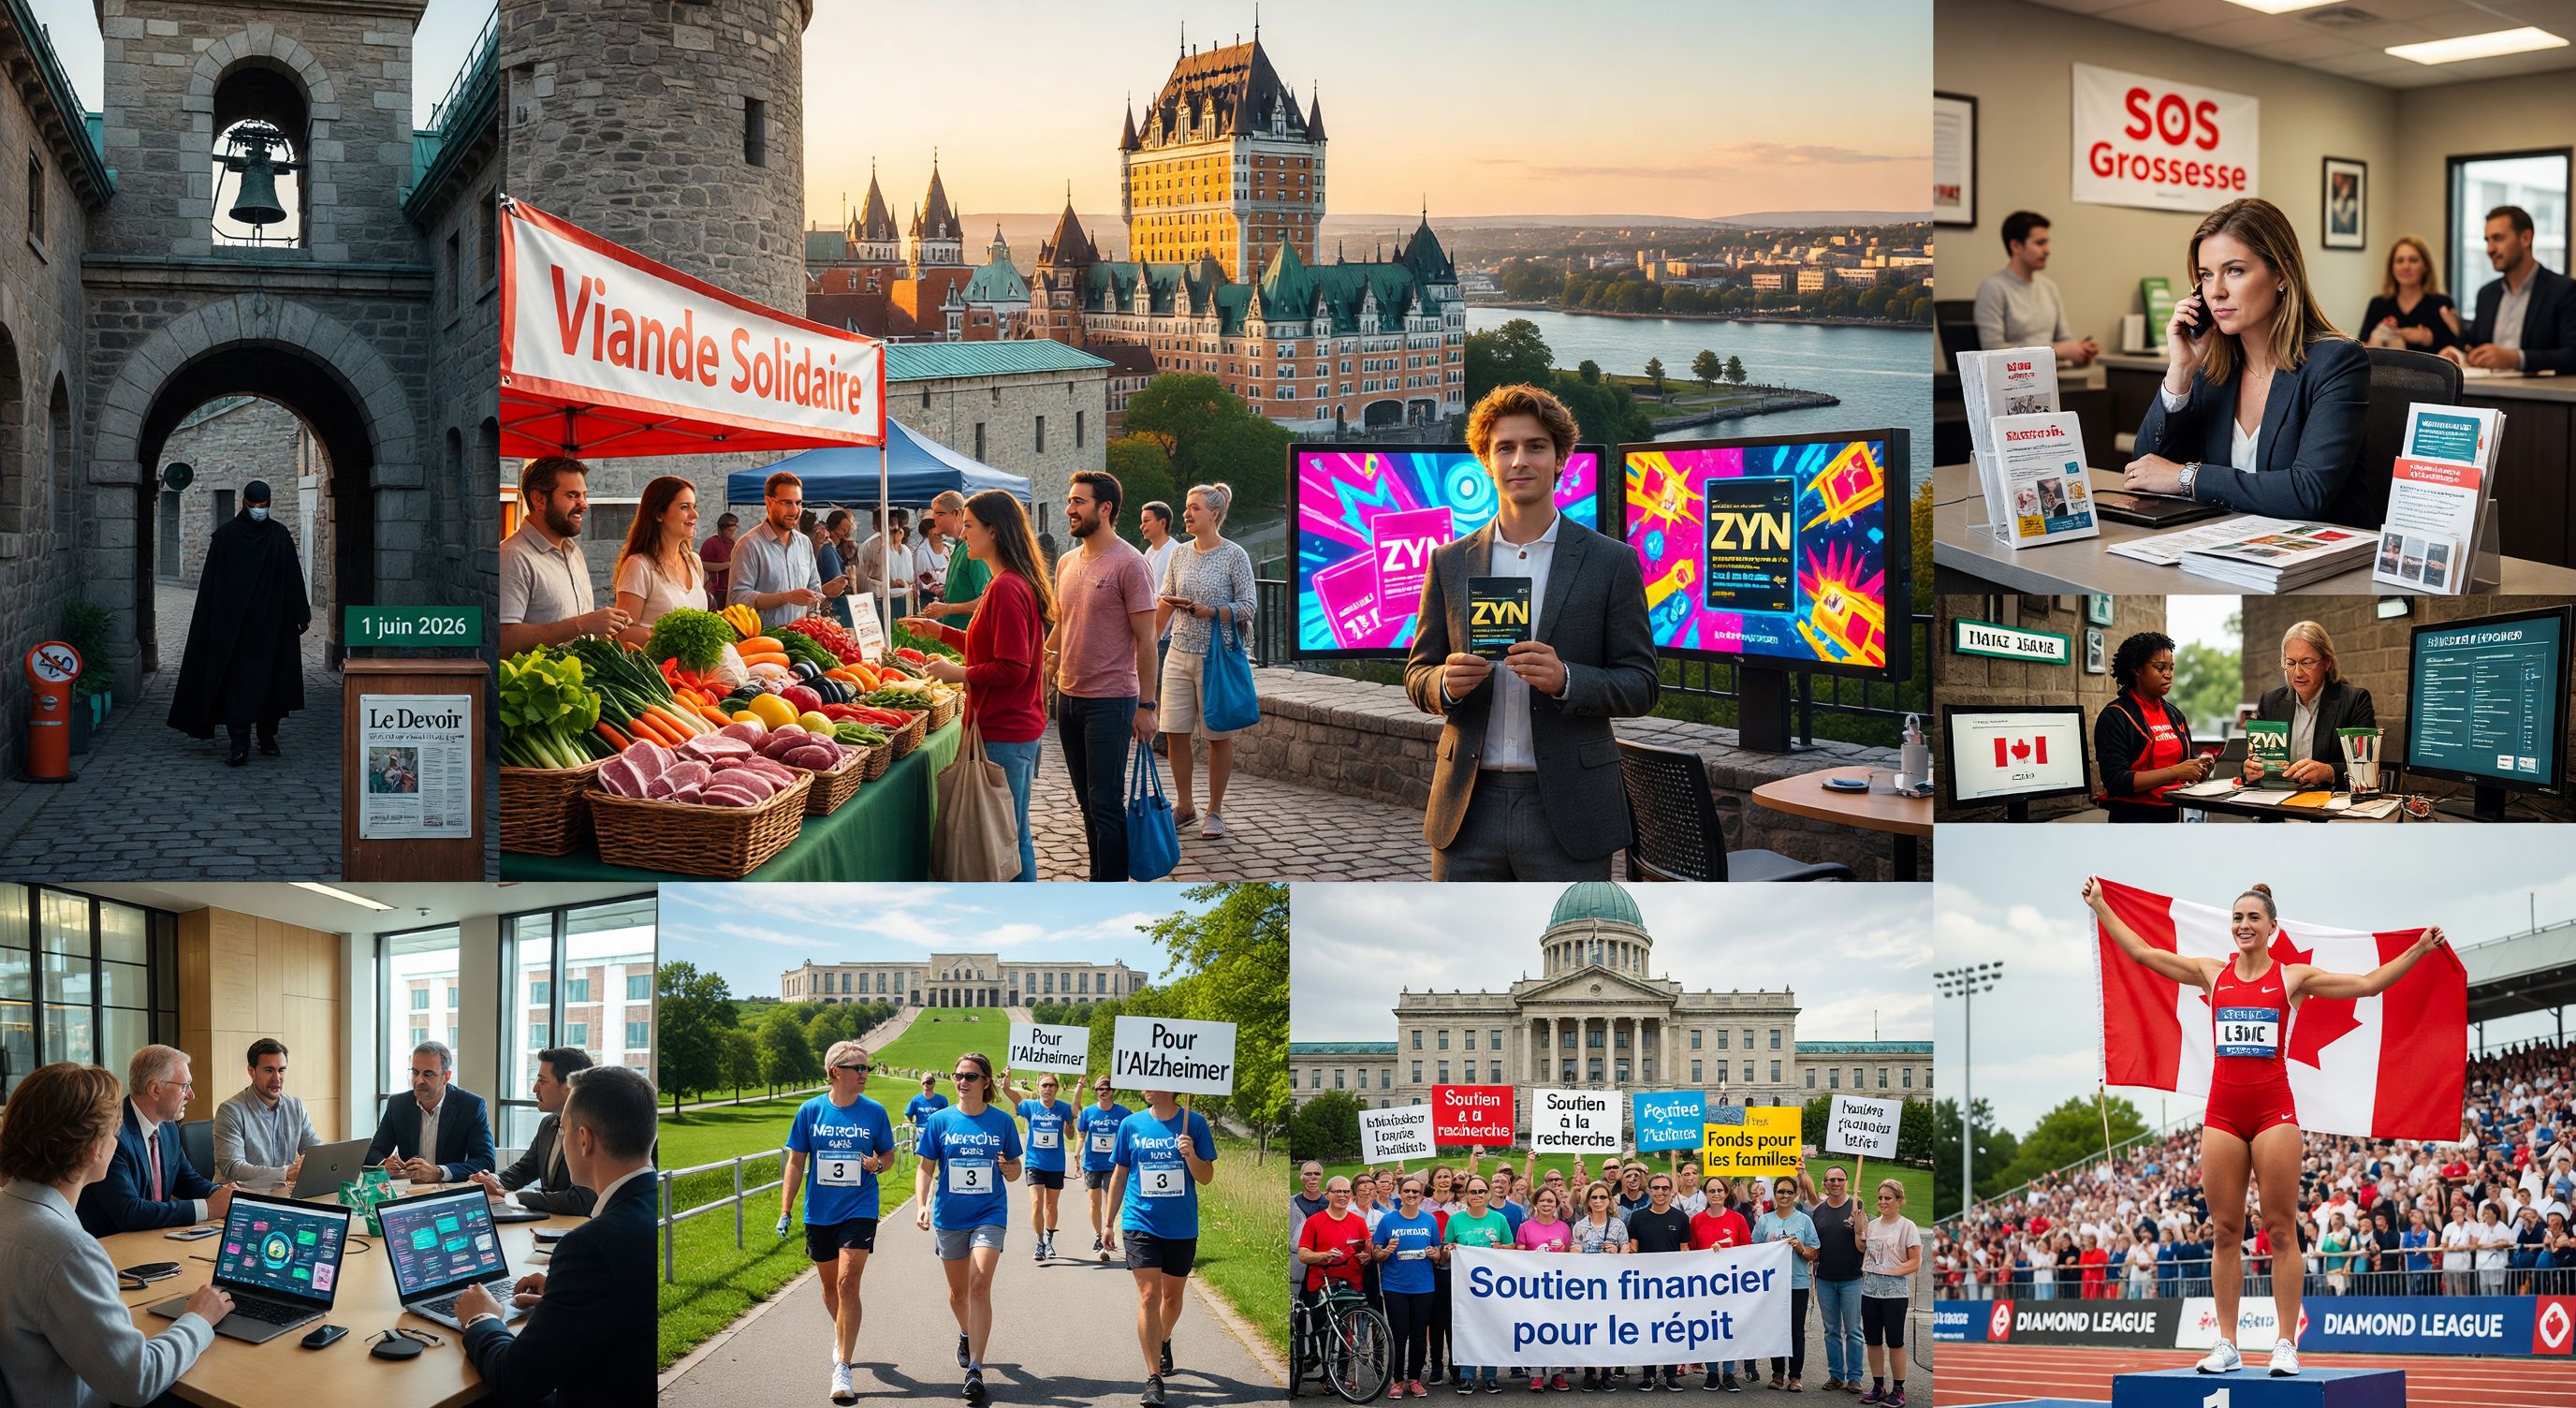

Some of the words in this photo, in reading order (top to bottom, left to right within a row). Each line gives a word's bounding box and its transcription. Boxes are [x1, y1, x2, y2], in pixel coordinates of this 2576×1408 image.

[2125, 86, 2219, 151] SOS
[2089, 141, 2247, 191] Grossesse
[550, 264, 719, 388] Viande
[730, 328, 861, 416] Solidaire
[1710, 512, 1791, 550] ZYN
[1471, 600, 1529, 625] ZYN
[361, 617, 371, 635] 1
[377, 616, 412, 639] juin
[418, 617, 466, 635] 2026
[369, 709, 394, 729] Le
[397, 709, 462, 729] Devoir
[1032, 1028, 1062, 1046] Pour
[1151, 1023, 1197, 1050] Pour
[1012, 1046, 1084, 1066] l'Alzheimer
[1117, 1049, 1230, 1081] l'Alzheimer
[1445, 1090, 1500, 1106] Soutien
[1546, 1093, 1605, 1111] Soutien
[1576, 1114, 1589, 1129] la
[1537, 1131, 1616, 1147] recherche
[1708, 1131, 1753, 1147] Fonds
[1758, 1136, 1796, 1151] pour
[1709, 1151, 1730, 1166] les
[1736, 1151, 1797, 1166] familles
[833, 1163, 844, 1179] 3
[965, 1170, 977, 1186] 3
[1156, 1174, 1168, 1189] 3
[1470, 1266, 1607, 1300] Soutien
[1617, 1264, 1776, 1300] financier
[1514, 1321, 1597, 1352] pour
[1608, 1314, 1639, 1345] le
[1651, 1310, 1734, 1350] répit
[2016, 1312, 2089, 1333] DIAMOND
[2092, 1312, 2157, 1334] LEAGUE
[2323, 1313, 2416, 1337] DIAMOND
[2421, 1313, 2504, 1338] LEAGUE
